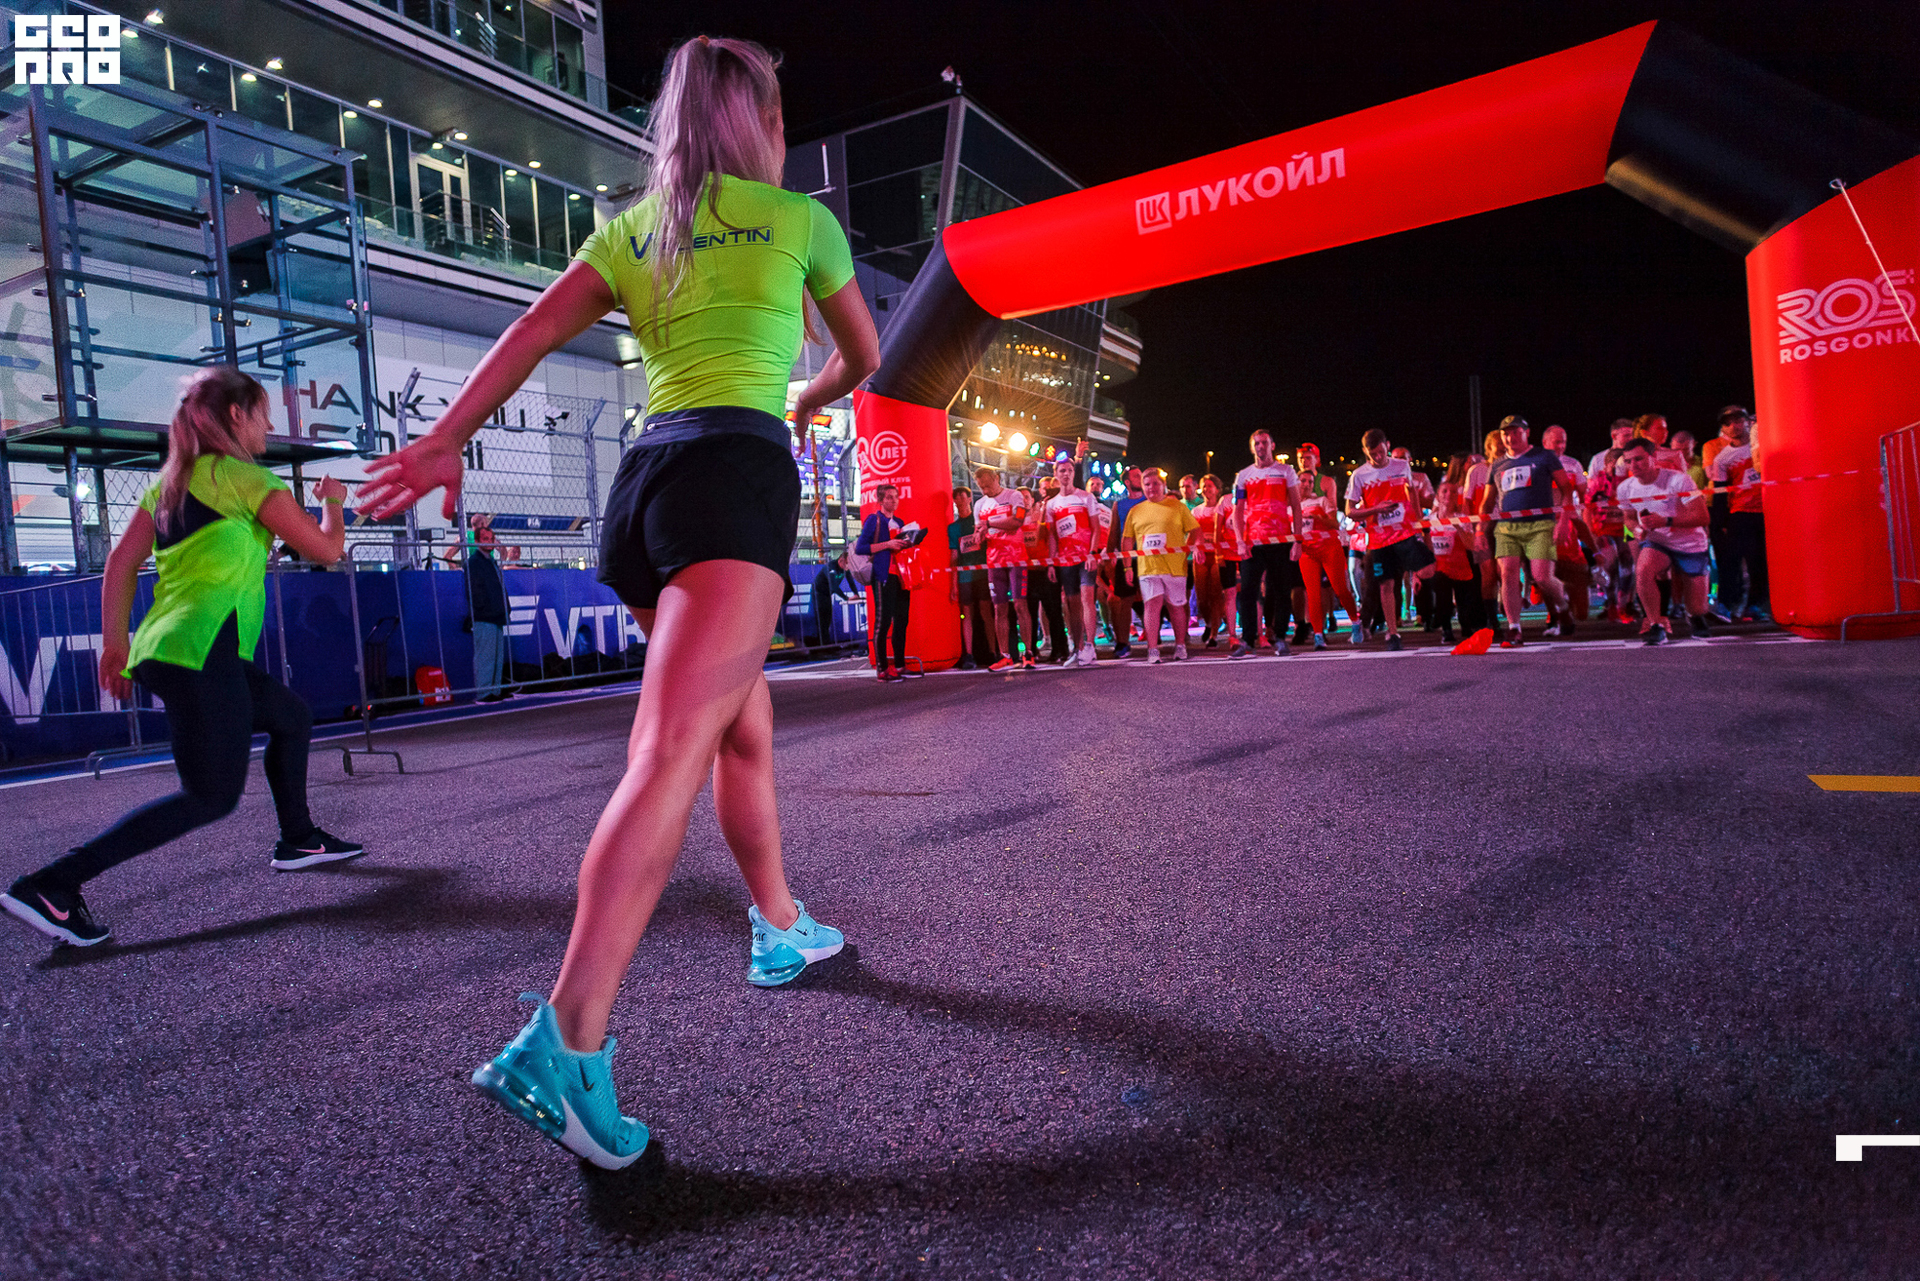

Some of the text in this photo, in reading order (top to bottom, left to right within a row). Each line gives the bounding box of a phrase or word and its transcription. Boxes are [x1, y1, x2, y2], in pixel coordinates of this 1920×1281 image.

[1175, 147, 1346, 221] ЛУКОЙЛ
[630, 229, 771, 260] VENTIN
[1777, 268, 1917, 346] ROS
[881, 445, 908, 460] ЛЕТ
